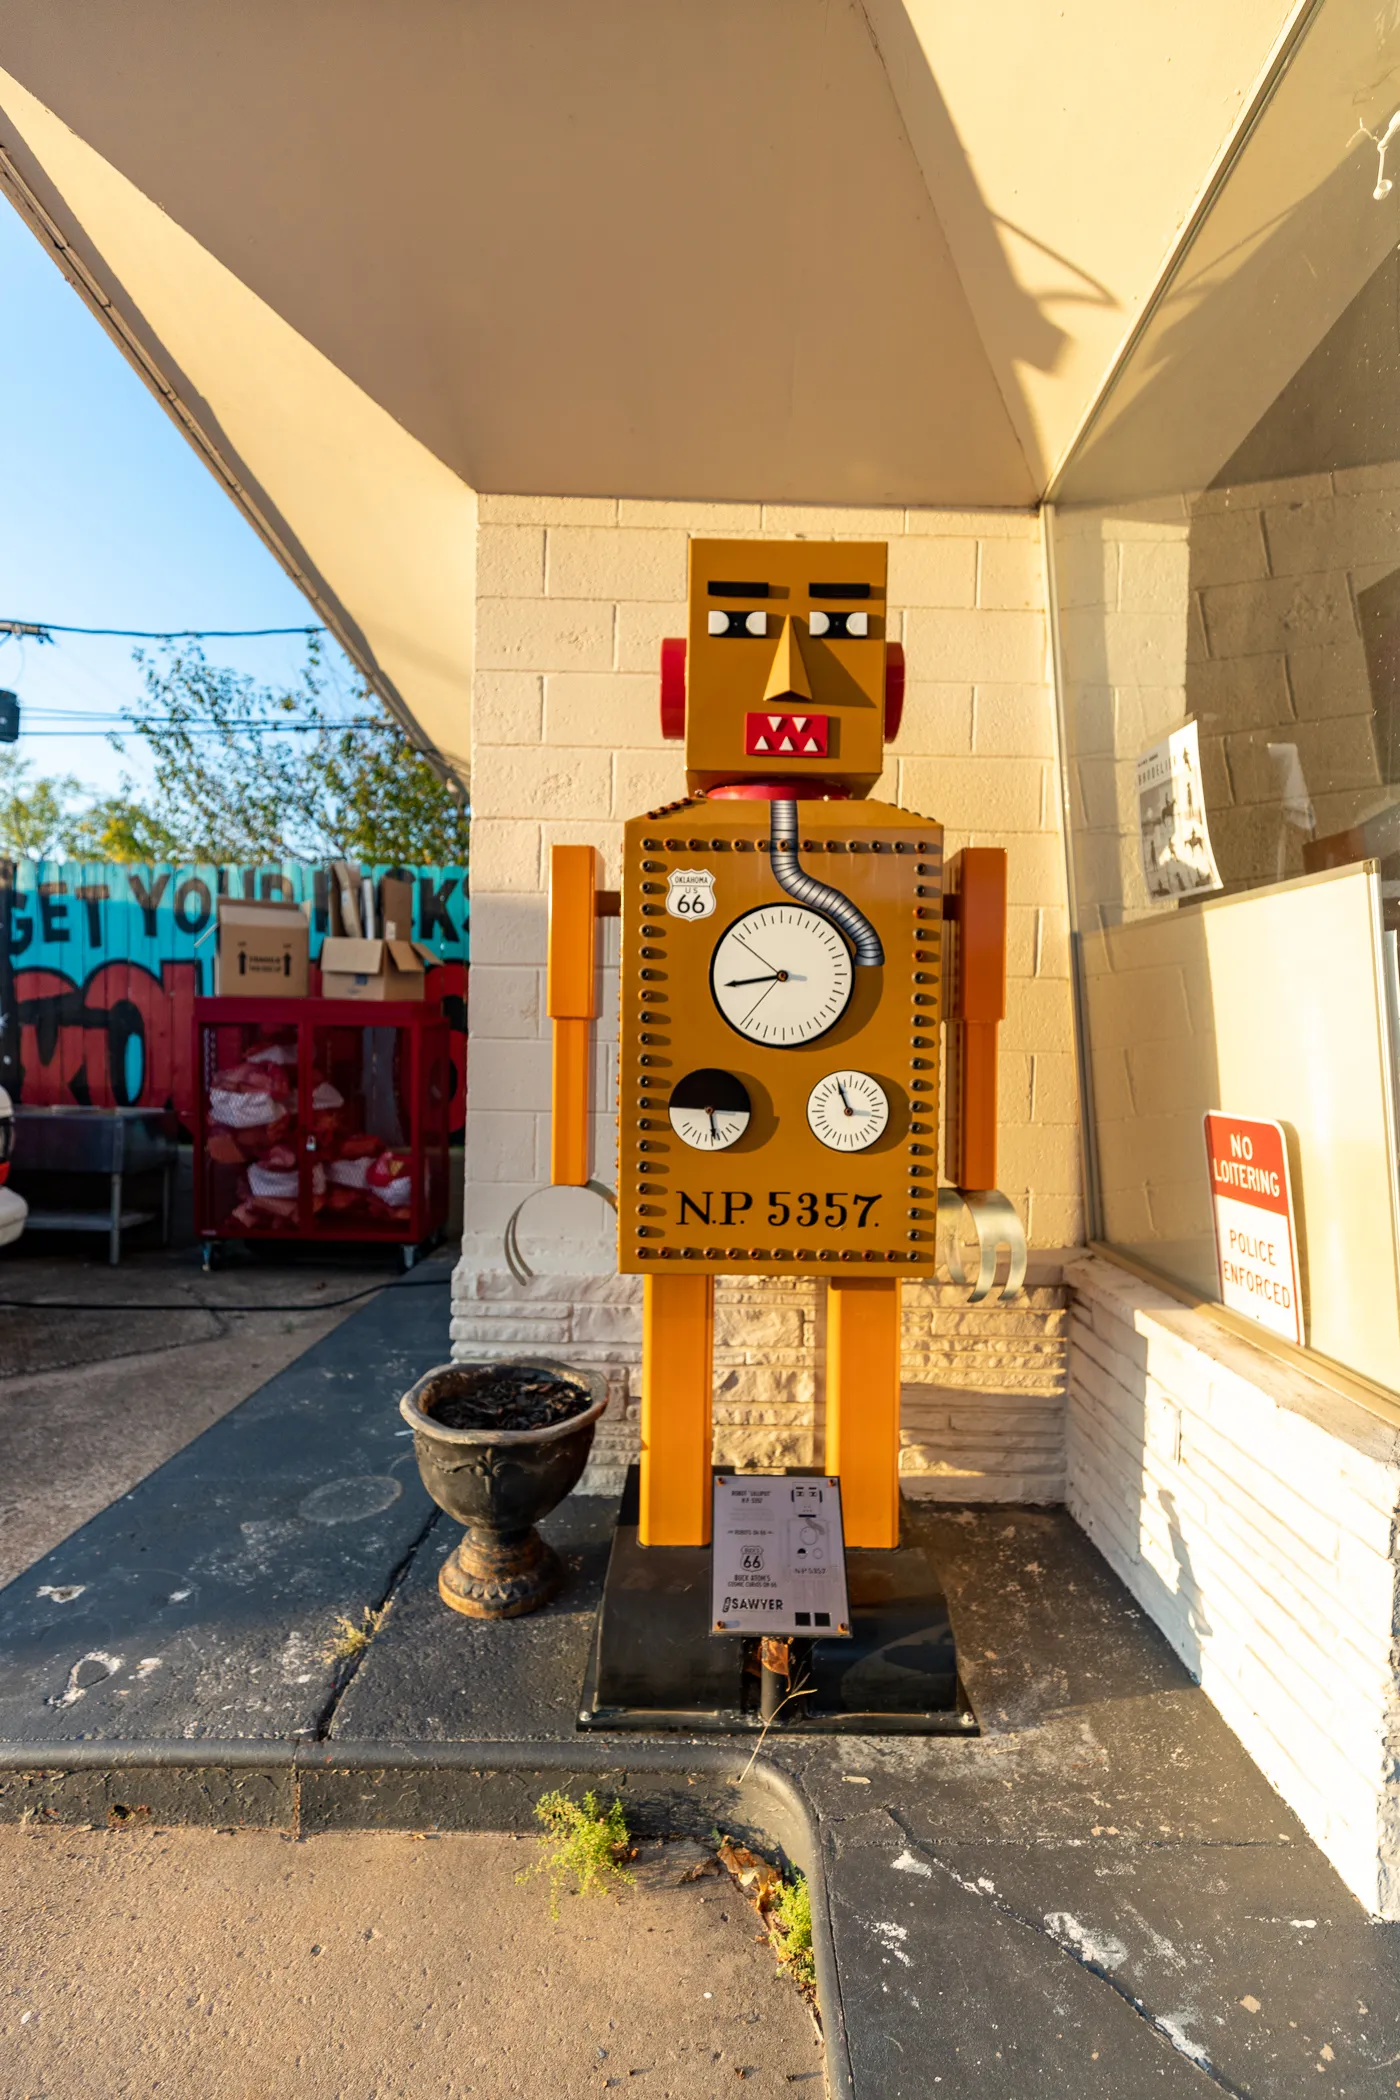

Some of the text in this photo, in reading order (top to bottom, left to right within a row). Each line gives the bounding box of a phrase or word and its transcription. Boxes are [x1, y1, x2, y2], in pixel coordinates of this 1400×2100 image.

[674, 875, 709, 884] OKLAHOMA
[677, 894, 705, 914] 66
[1230, 1133, 1254, 1160] NO
[1213, 1158, 1281, 1198] LOITERING
[675, 1190, 753, 1225] N.P.
[1229, 1228, 1277, 1266] POLICE
[1223, 1260, 1291, 1309] ENFORCED
[743, 1555, 761, 1569] 66
[731, 1598, 784, 1611] SAWYER
